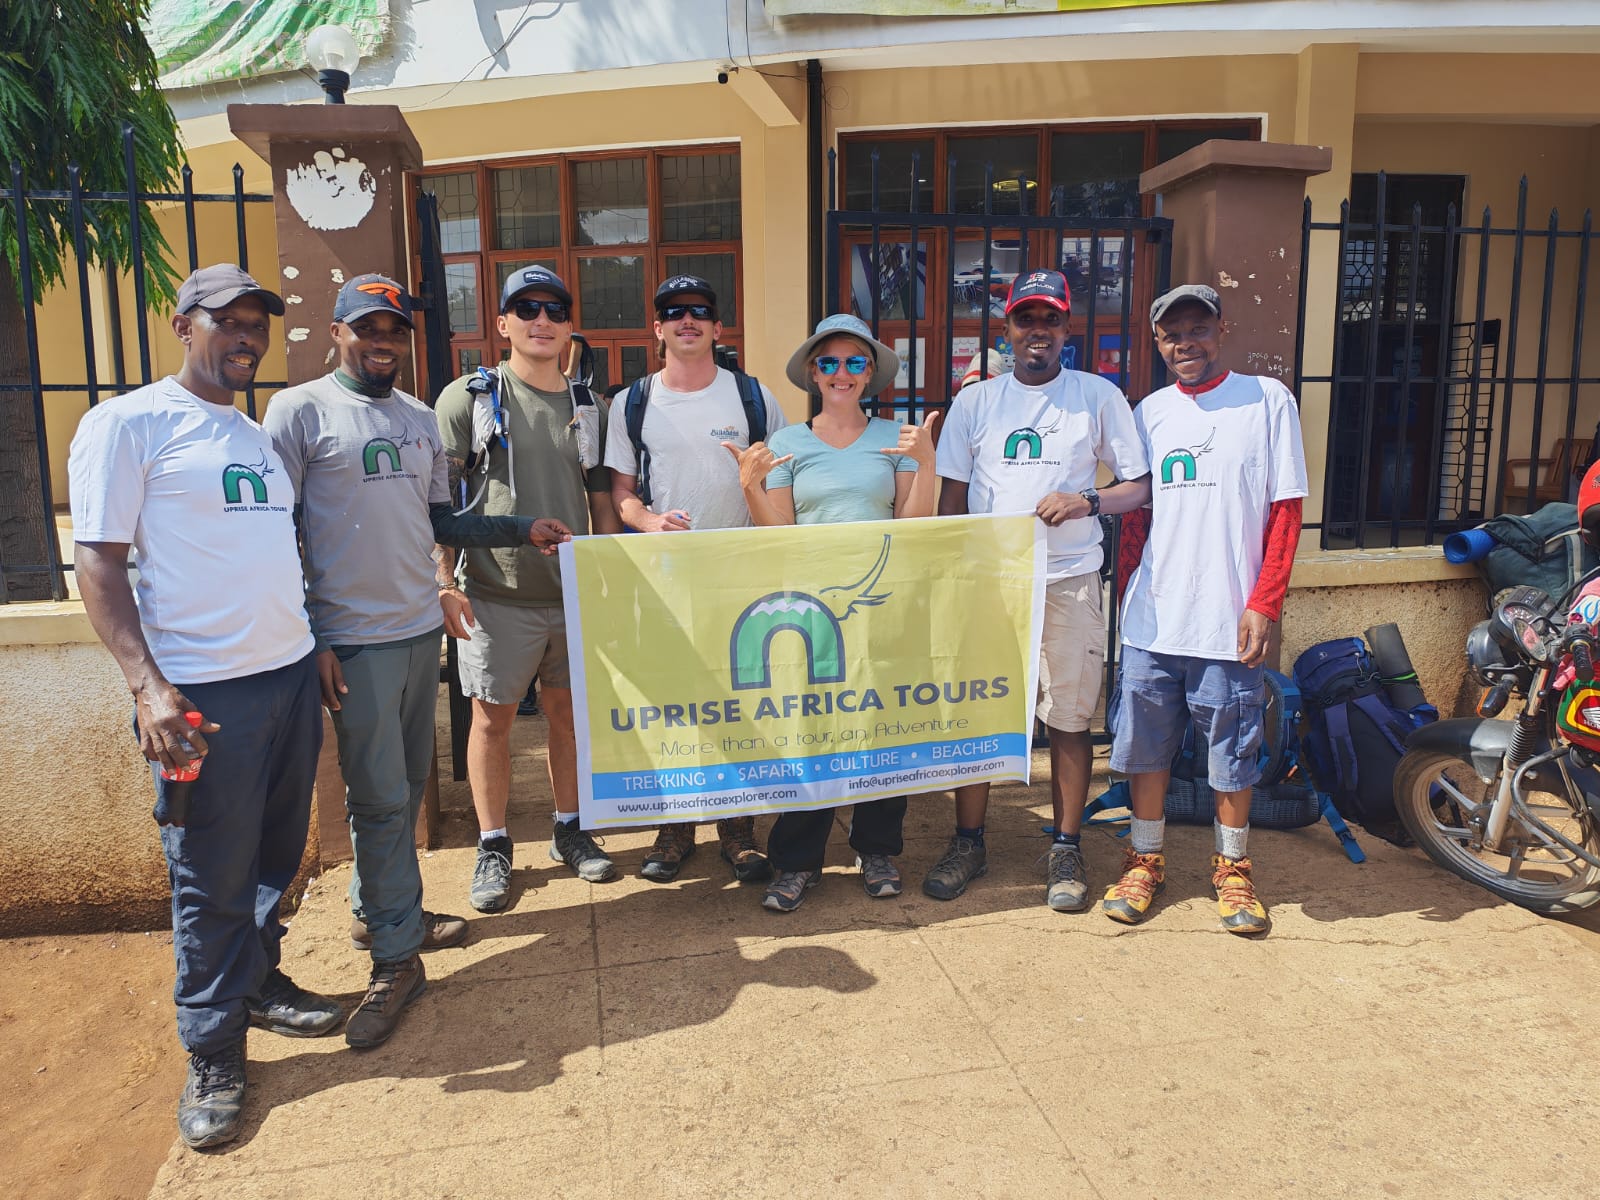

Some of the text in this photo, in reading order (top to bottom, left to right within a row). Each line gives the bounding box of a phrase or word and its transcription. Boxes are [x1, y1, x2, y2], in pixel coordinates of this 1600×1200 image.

[363, 475, 384, 483] UPRISE
[223, 505, 249, 513] UPRISE
[610, 676, 1010, 732] UPRISE AFRICA TOURS
[660, 740, 715, 758] More
[722, 734, 766, 753] than
[773, 735, 789, 747] a
[840, 728, 867, 741] an
[875, 718, 969, 738] Adventure
[622, 738, 1000, 792] TREKKING SAFARIS CULTURE BEACHES
[848, 760, 1005, 790] info@upriseafricaexplorer.com
[617, 788, 798, 813] www.upriseafricaexplorer.com
